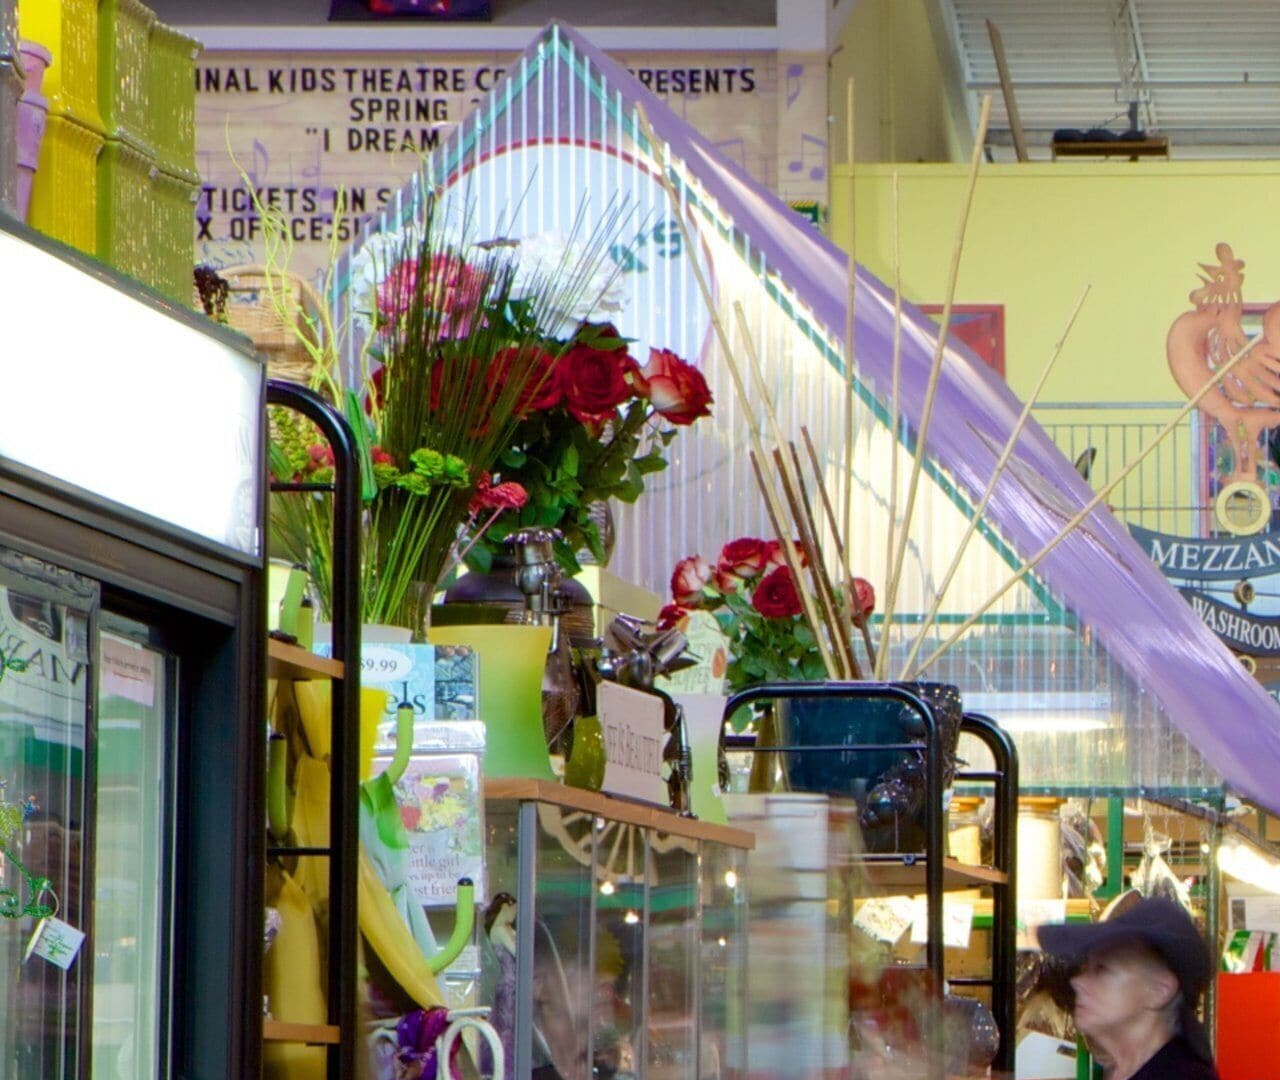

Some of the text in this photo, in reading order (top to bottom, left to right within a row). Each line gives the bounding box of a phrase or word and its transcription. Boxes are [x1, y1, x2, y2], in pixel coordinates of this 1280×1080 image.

[268, 68, 336, 92] KIDS
[343, 69, 465, 92] THEATRE
[350, 98, 448, 121] SPRING
[348, 128, 440, 151] DREAM
[203, 188, 317, 212] TICKETS
